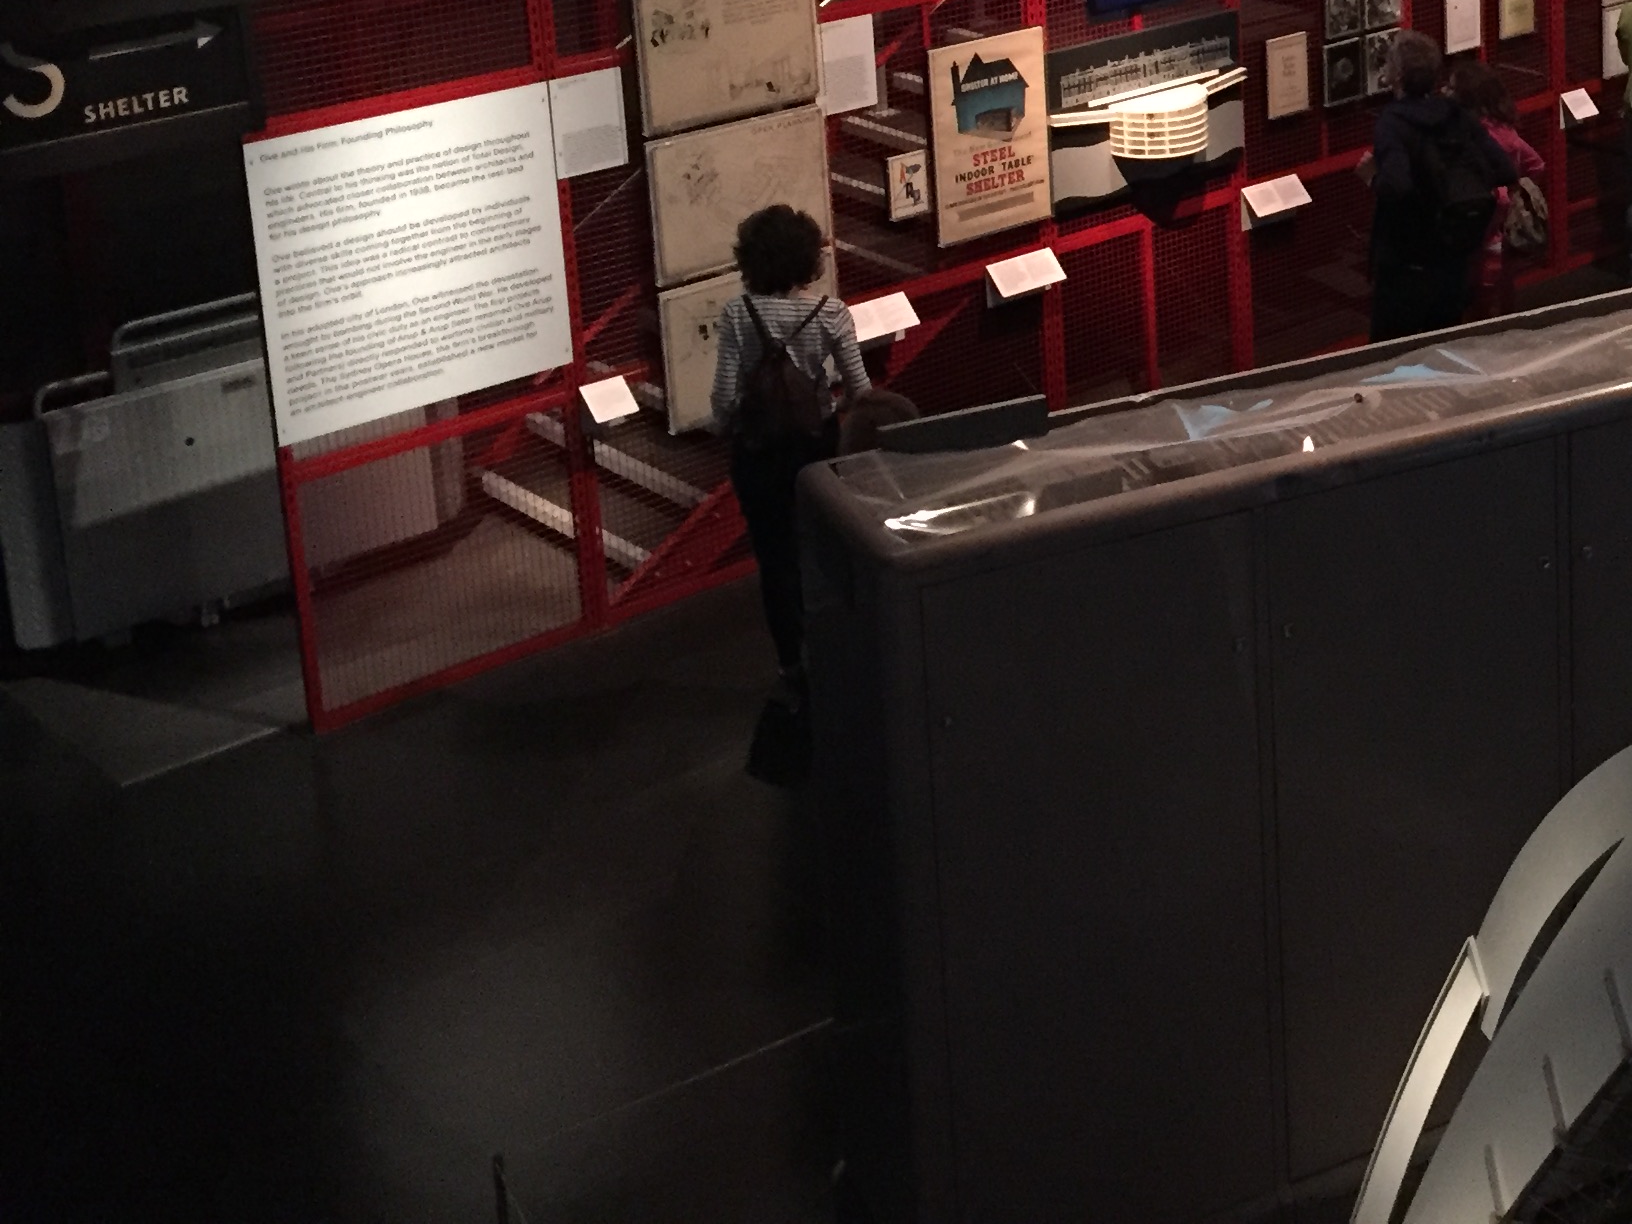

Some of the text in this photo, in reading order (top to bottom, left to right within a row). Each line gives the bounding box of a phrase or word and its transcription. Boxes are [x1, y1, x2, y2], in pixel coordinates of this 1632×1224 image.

[84, 86, 190, 124] SHELTER
[340, 130, 383, 146] Founding
[384, 119, 433, 137] Philosophy
[339, 169, 355, 178] the
[386, 158, 404, 168] and
[955, 155, 1034, 184] INDOOR TABLE
[972, 145, 1016, 167] STEEL
[966, 169, 1026, 196] SHELTER
[358, 193, 396, 208] founded
